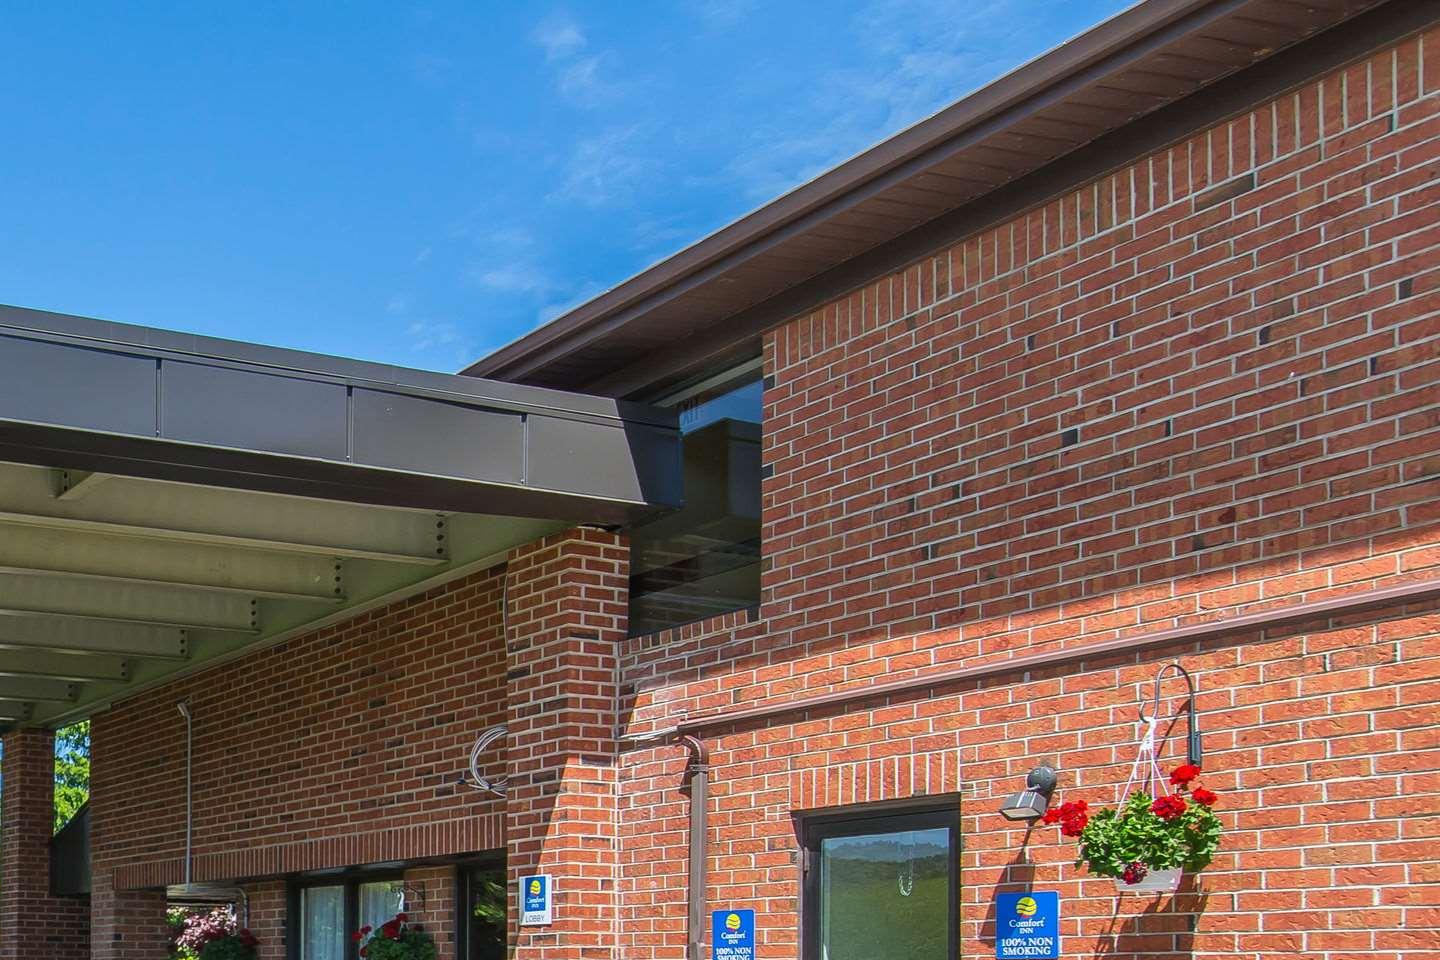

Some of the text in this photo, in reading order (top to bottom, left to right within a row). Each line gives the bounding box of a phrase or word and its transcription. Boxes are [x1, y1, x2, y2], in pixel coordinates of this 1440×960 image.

[526, 914, 544, 922] LOBBY
[1009, 919, 1044, 927] Comfort
[721, 931, 746, 939] Comfort
[1002, 937, 1053, 946] 100% NON
[716, 947, 733, 955] 100%
[1002, 947, 1051, 955] SMOKING
